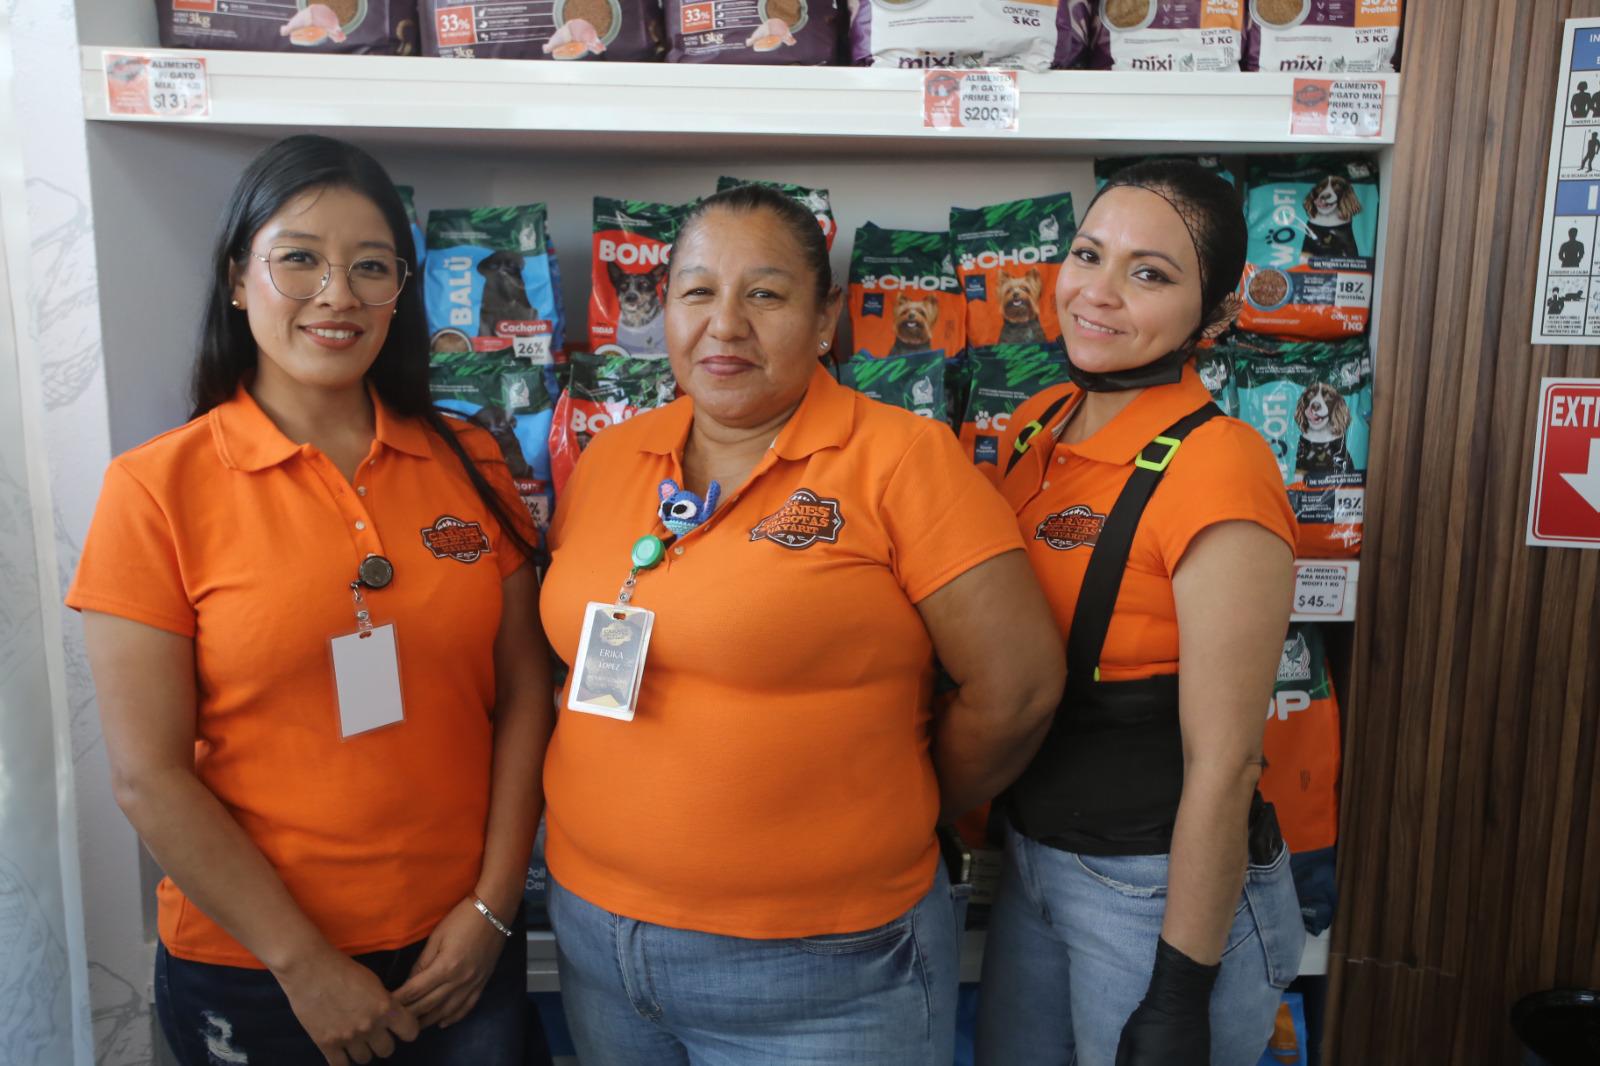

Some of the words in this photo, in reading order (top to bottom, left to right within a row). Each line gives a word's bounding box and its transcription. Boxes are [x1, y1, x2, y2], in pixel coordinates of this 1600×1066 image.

[685, 8, 710, 23] 33%
[440, 14, 470, 32] 33%
[1022, 17, 1040, 27] KG
[1217, 36, 1233, 44] KG
[1372, 35, 1388, 43] KG
[152, 61, 201, 69] ALIMENTO
[899, 51, 955, 69] mixi
[1132, 54, 1173, 71] mixi
[1280, 56, 1323, 71] mixi
[169, 71, 196, 79] GATO
[1328, 101, 1354, 109] PRIME
[977, 245, 1058, 269] CHOP
[879, 274, 960, 291] CHOP
[1340, 281, 1364, 294] 18%
[500, 322, 547, 332] Cachorro
[518, 342, 544, 354] 26%
[600, 648, 624, 660] ERIKA
